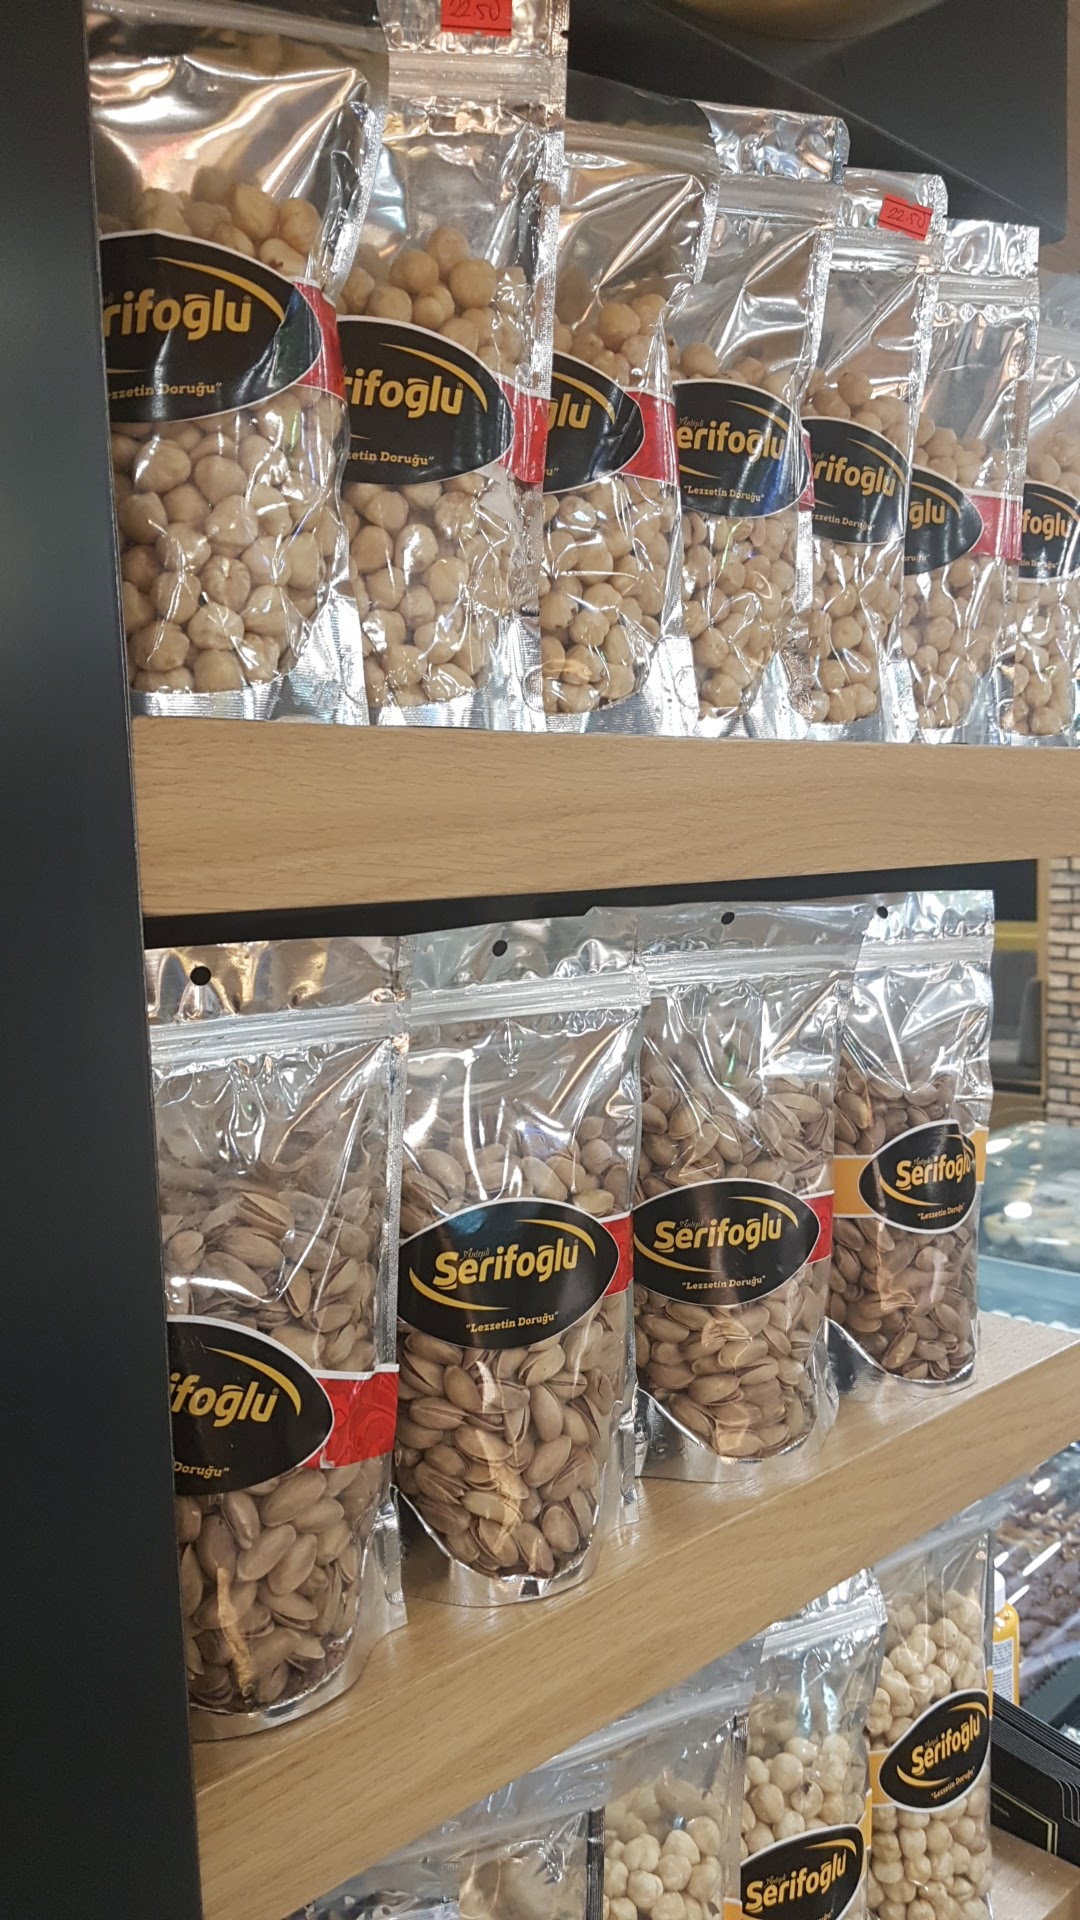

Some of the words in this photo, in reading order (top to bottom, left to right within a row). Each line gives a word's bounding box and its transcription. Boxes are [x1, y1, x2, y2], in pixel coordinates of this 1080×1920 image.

[886, 207, 927, 229] 22.50
[103, 288, 251, 341] rifoğlu
[345, 368, 464, 419] ifoğlu
[676, 420, 786, 463] erifoğlu
[814, 454, 896, 497] rifoğlu
[1021, 508, 1073, 541] foğlu
[169, 1372, 279, 1428] ifoğlu
